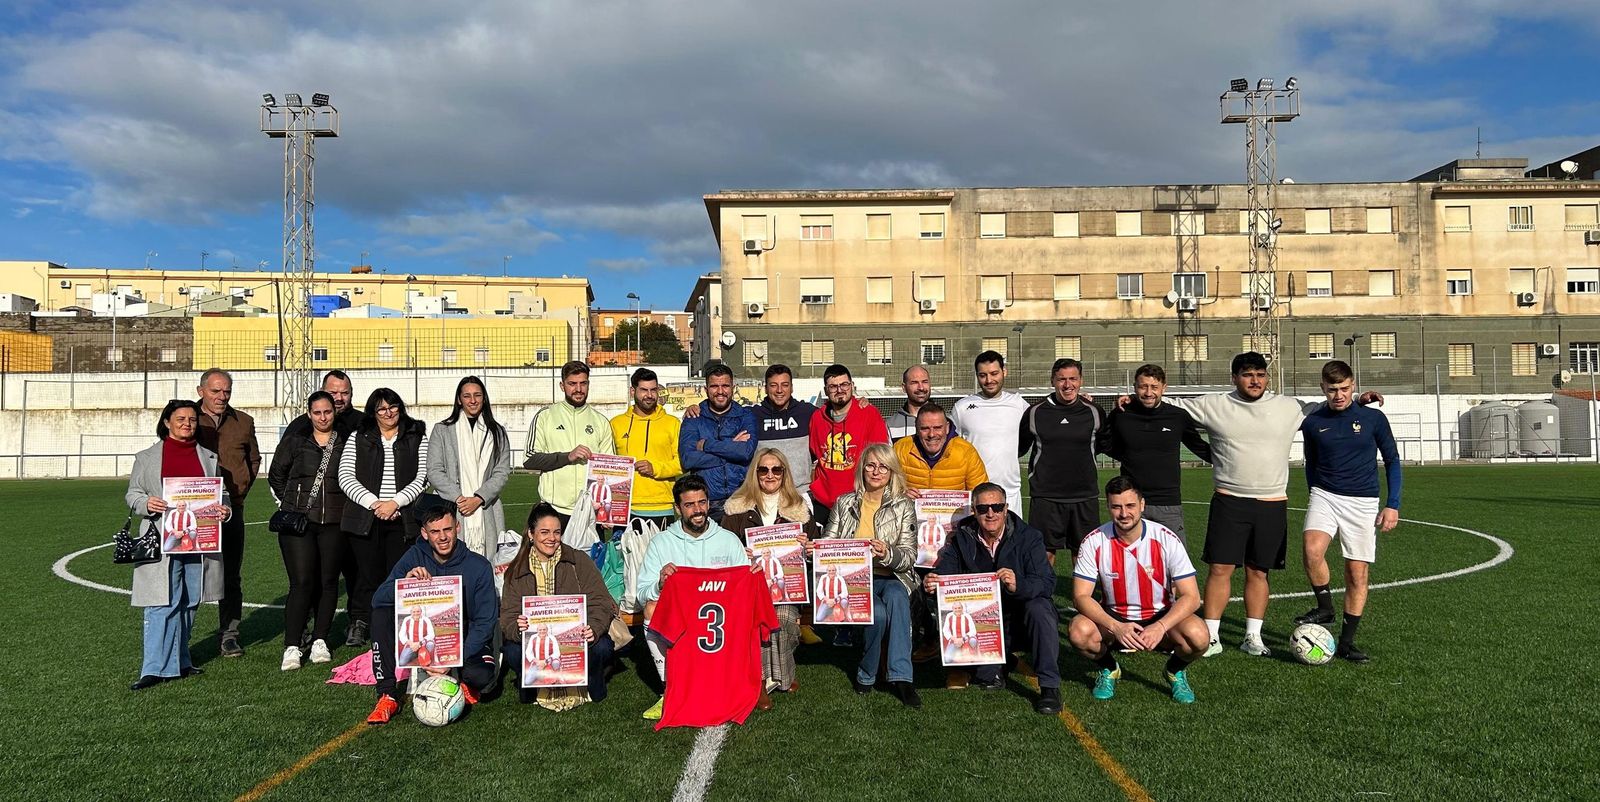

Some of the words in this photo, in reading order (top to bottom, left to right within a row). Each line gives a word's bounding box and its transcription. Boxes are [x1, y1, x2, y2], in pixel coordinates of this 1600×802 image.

[763, 417, 798, 431] FILA
[428, 588, 454, 596] MUÑOZ
[698, 581, 726, 592] JAVI
[554, 606, 579, 614] MUÑOZ
[698, 602, 726, 653] 3
[372, 642, 384, 680] PARIS
